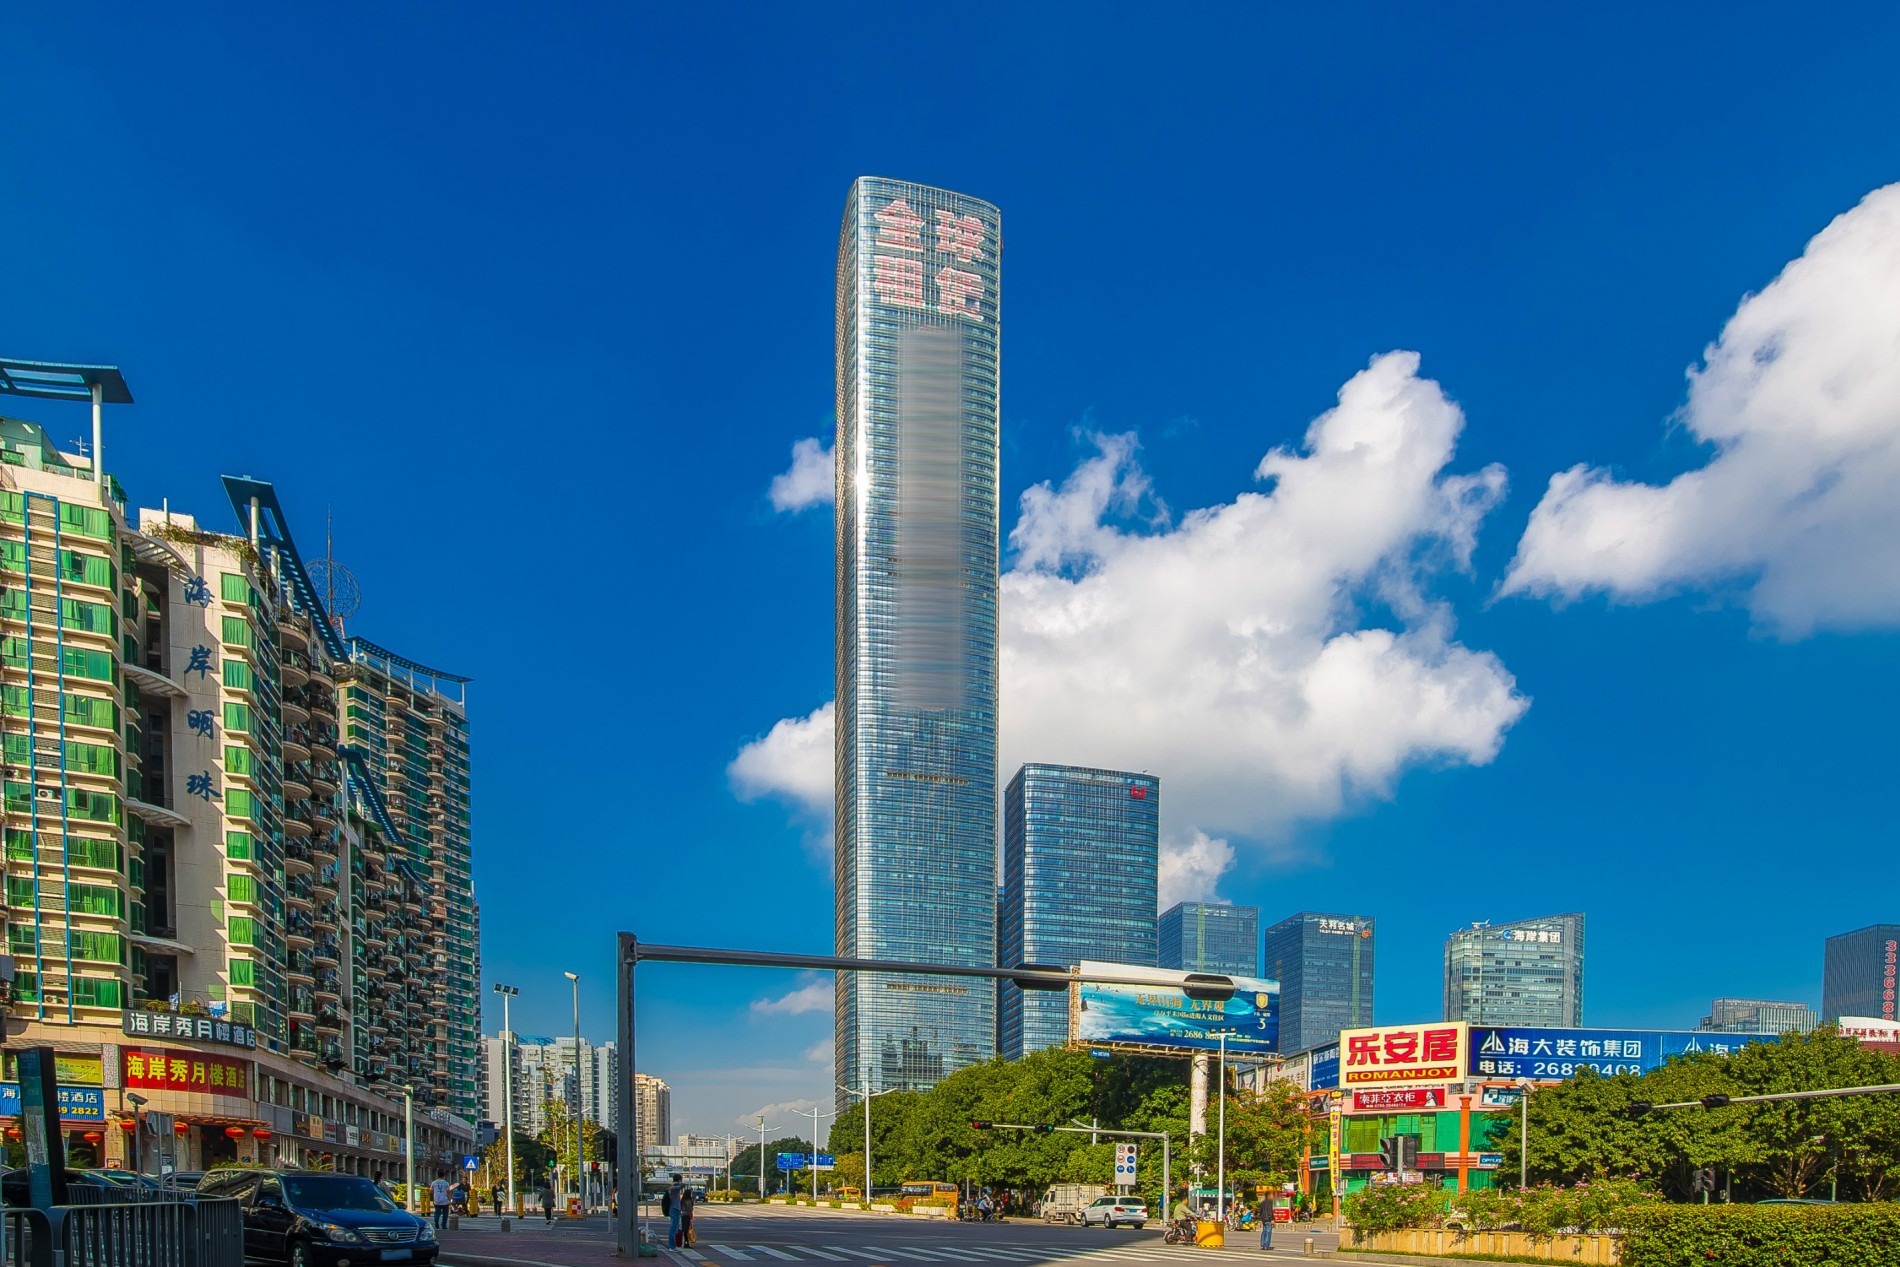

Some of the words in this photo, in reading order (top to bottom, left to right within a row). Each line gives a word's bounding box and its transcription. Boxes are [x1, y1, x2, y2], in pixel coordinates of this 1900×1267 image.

[183, 575, 222, 802] 海岸明珠
[1514, 929, 1561, 944] 海岸集团
[1257, 1018, 1266, 1030] 3
[1184, 1029, 1203, 1039] 2686
[1347, 1028, 1458, 1066] 乐安居
[1508, 1037, 1641, 1058] 海大装饰集团
[127, 1055, 245, 1089] 海岸秀月楼酒店
[1348, 1067, 1455, 1081] ROMANJOY
[71, 1107, 99, 1116] 2822
